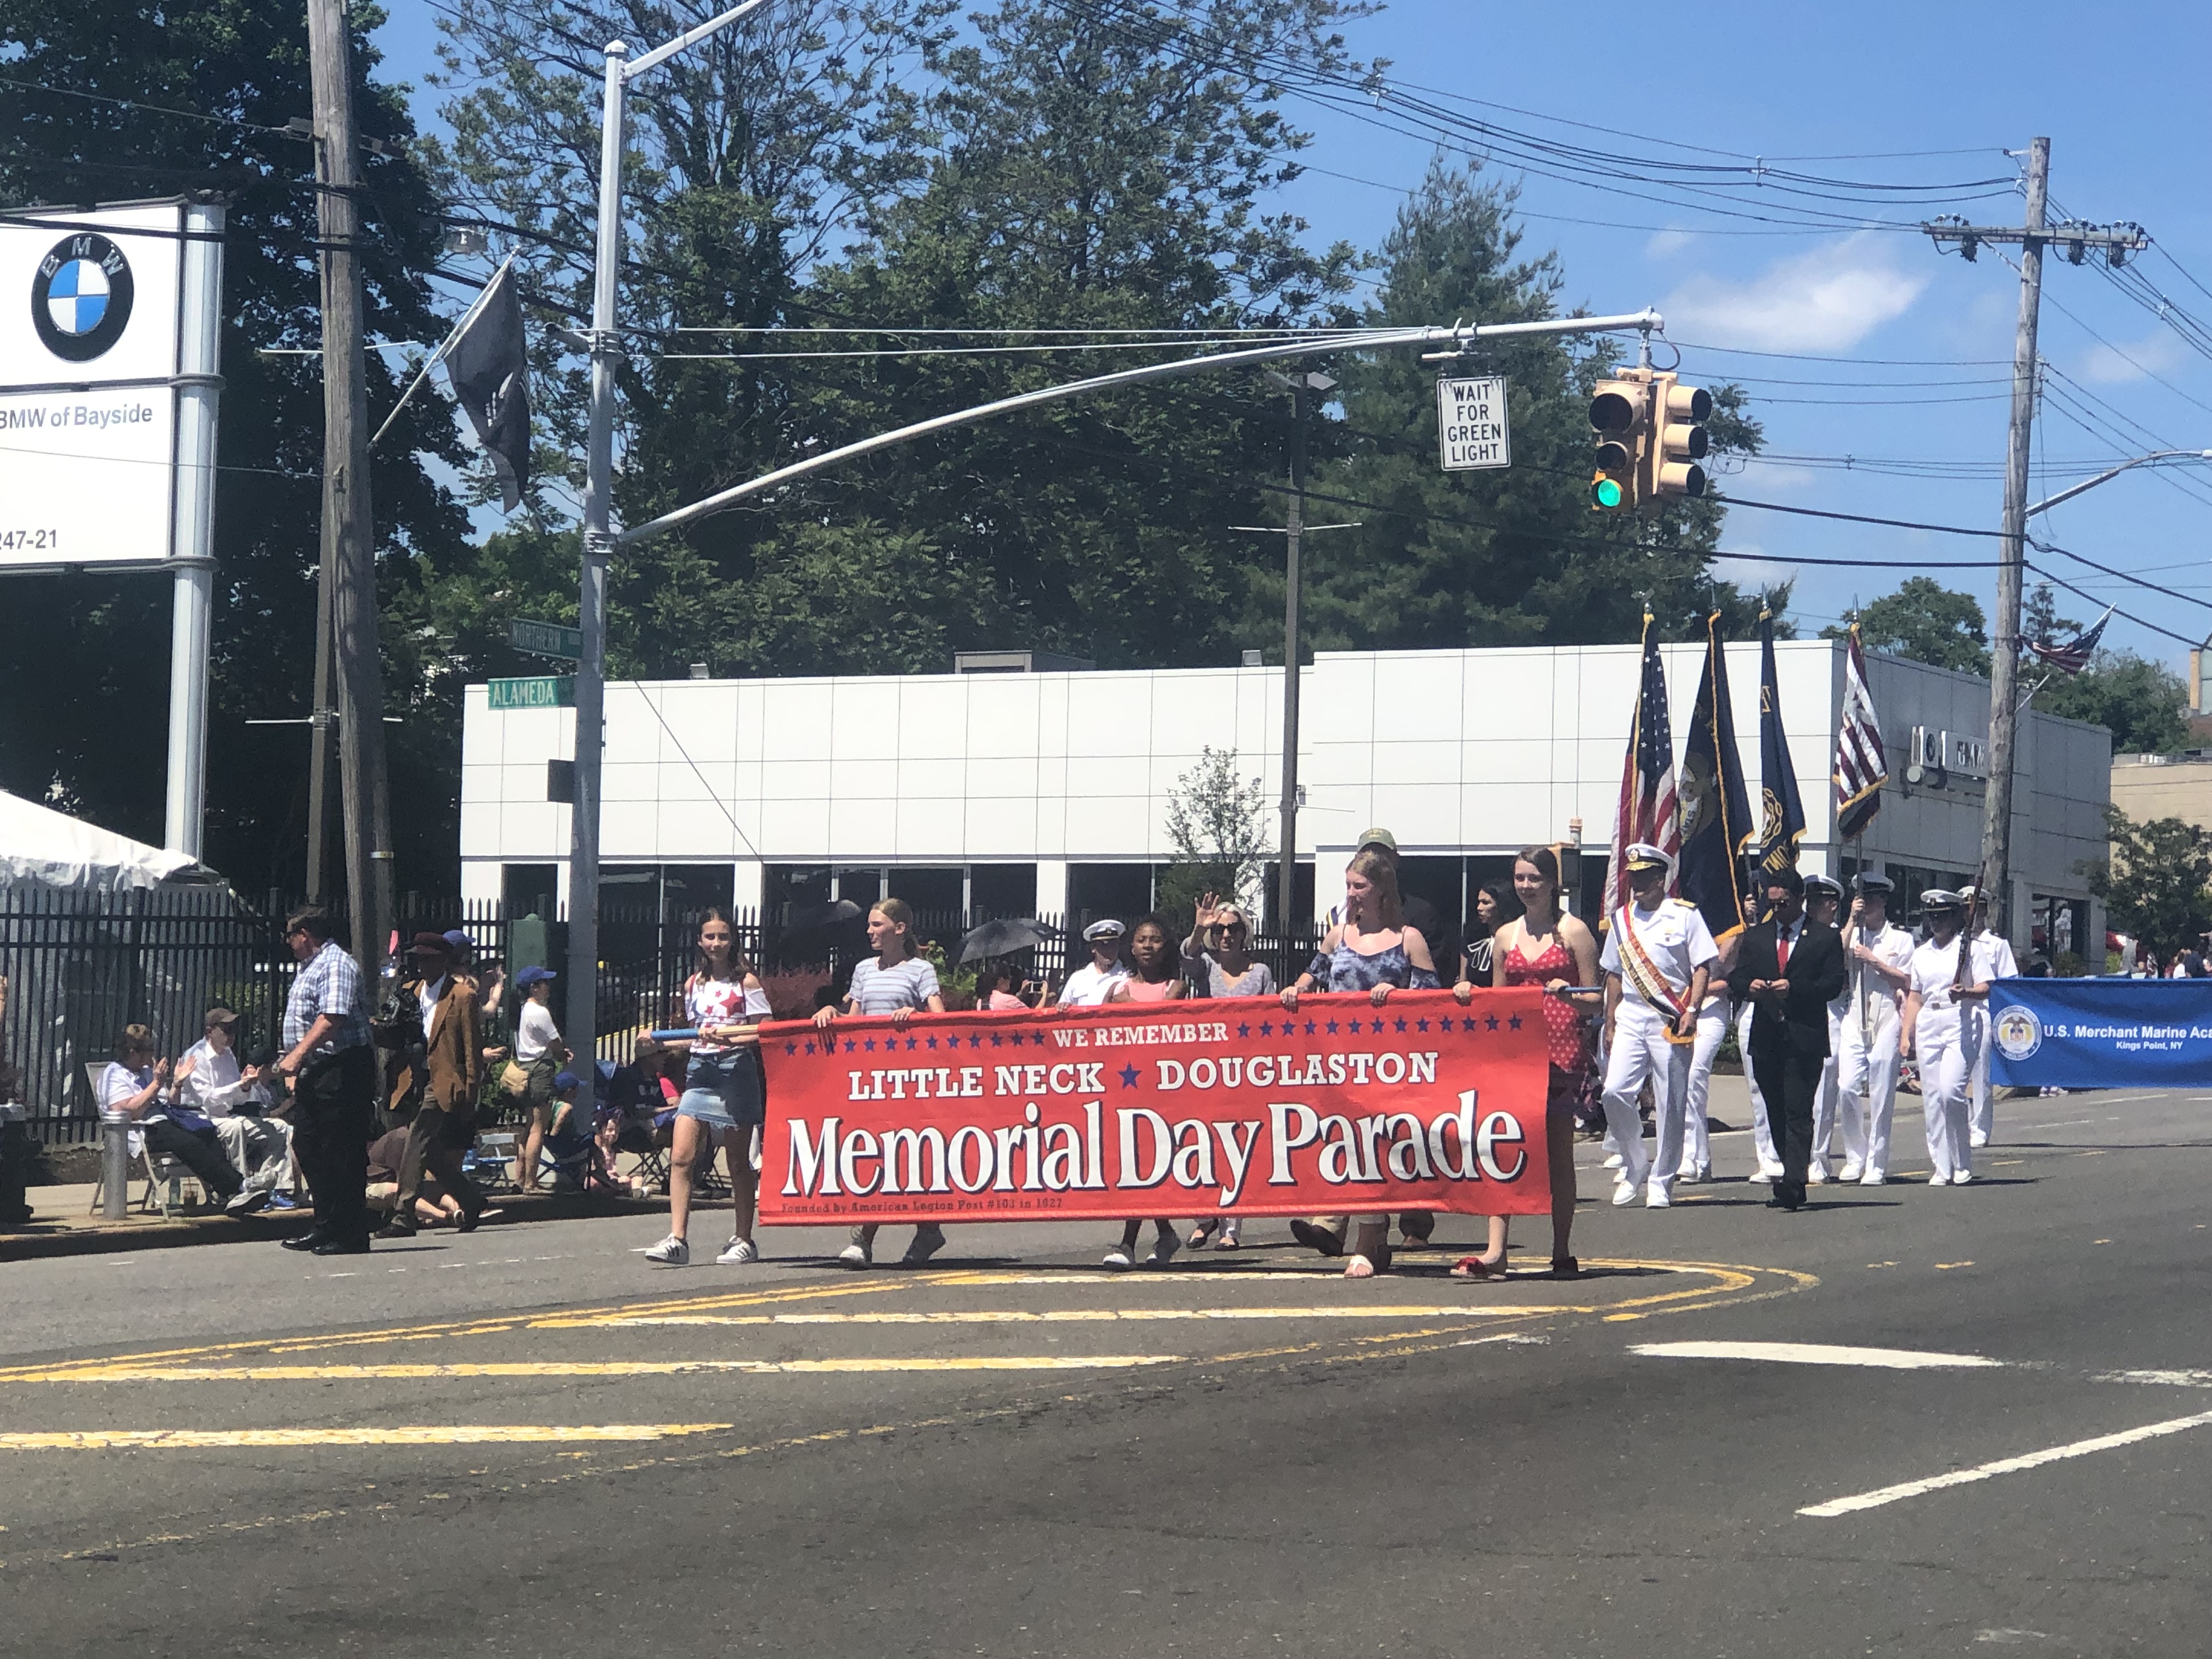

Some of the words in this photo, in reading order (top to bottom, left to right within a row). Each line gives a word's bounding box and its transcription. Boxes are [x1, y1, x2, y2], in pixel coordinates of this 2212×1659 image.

[40, 237, 124, 279] BMW
[1453, 384, 1490, 402] WAIT
[0, 408, 47, 430] BMW
[50, 407, 70, 427] of
[74, 403, 153, 430] Bayside
[1457, 404, 1489, 422] FOR
[1448, 424, 1502, 442] GREEN
[1452, 443, 1499, 462] LIGHT
[492, 681, 555, 706] ALAMEDA
[1052, 1029, 1089, 1047] WE
[1094, 1023, 1229, 1047] REMEMBER
[2044, 1025, 2070, 1037] U.S.
[2075, 1025, 2138, 1039] Merchant
[2141, 1026, 2187, 1039] Marine
[2116, 1041, 2141, 1051] Kings
[2143, 1041, 2168, 1051] Point,
[2170, 1041, 2183, 1049] NY
[848, 1066, 983, 1101] LITTLE
[994, 1062, 1105, 1096] NECK
[1155, 1051, 1440, 1090] DOUGLASTON
[780, 1099, 1108, 1198] Memorial
[1115, 1107, 1262, 1207] Day
[1266, 1088, 1526, 1185] Parade
[781, 1203, 830, 1214] Founded
[833, 1202, 847, 1214] by
[851, 1201, 908, 1212] American
[913, 1200, 953, 1212] Legion
[958, 1199, 984, 1210] Post
[1020, 1198, 1031, 1209] in
